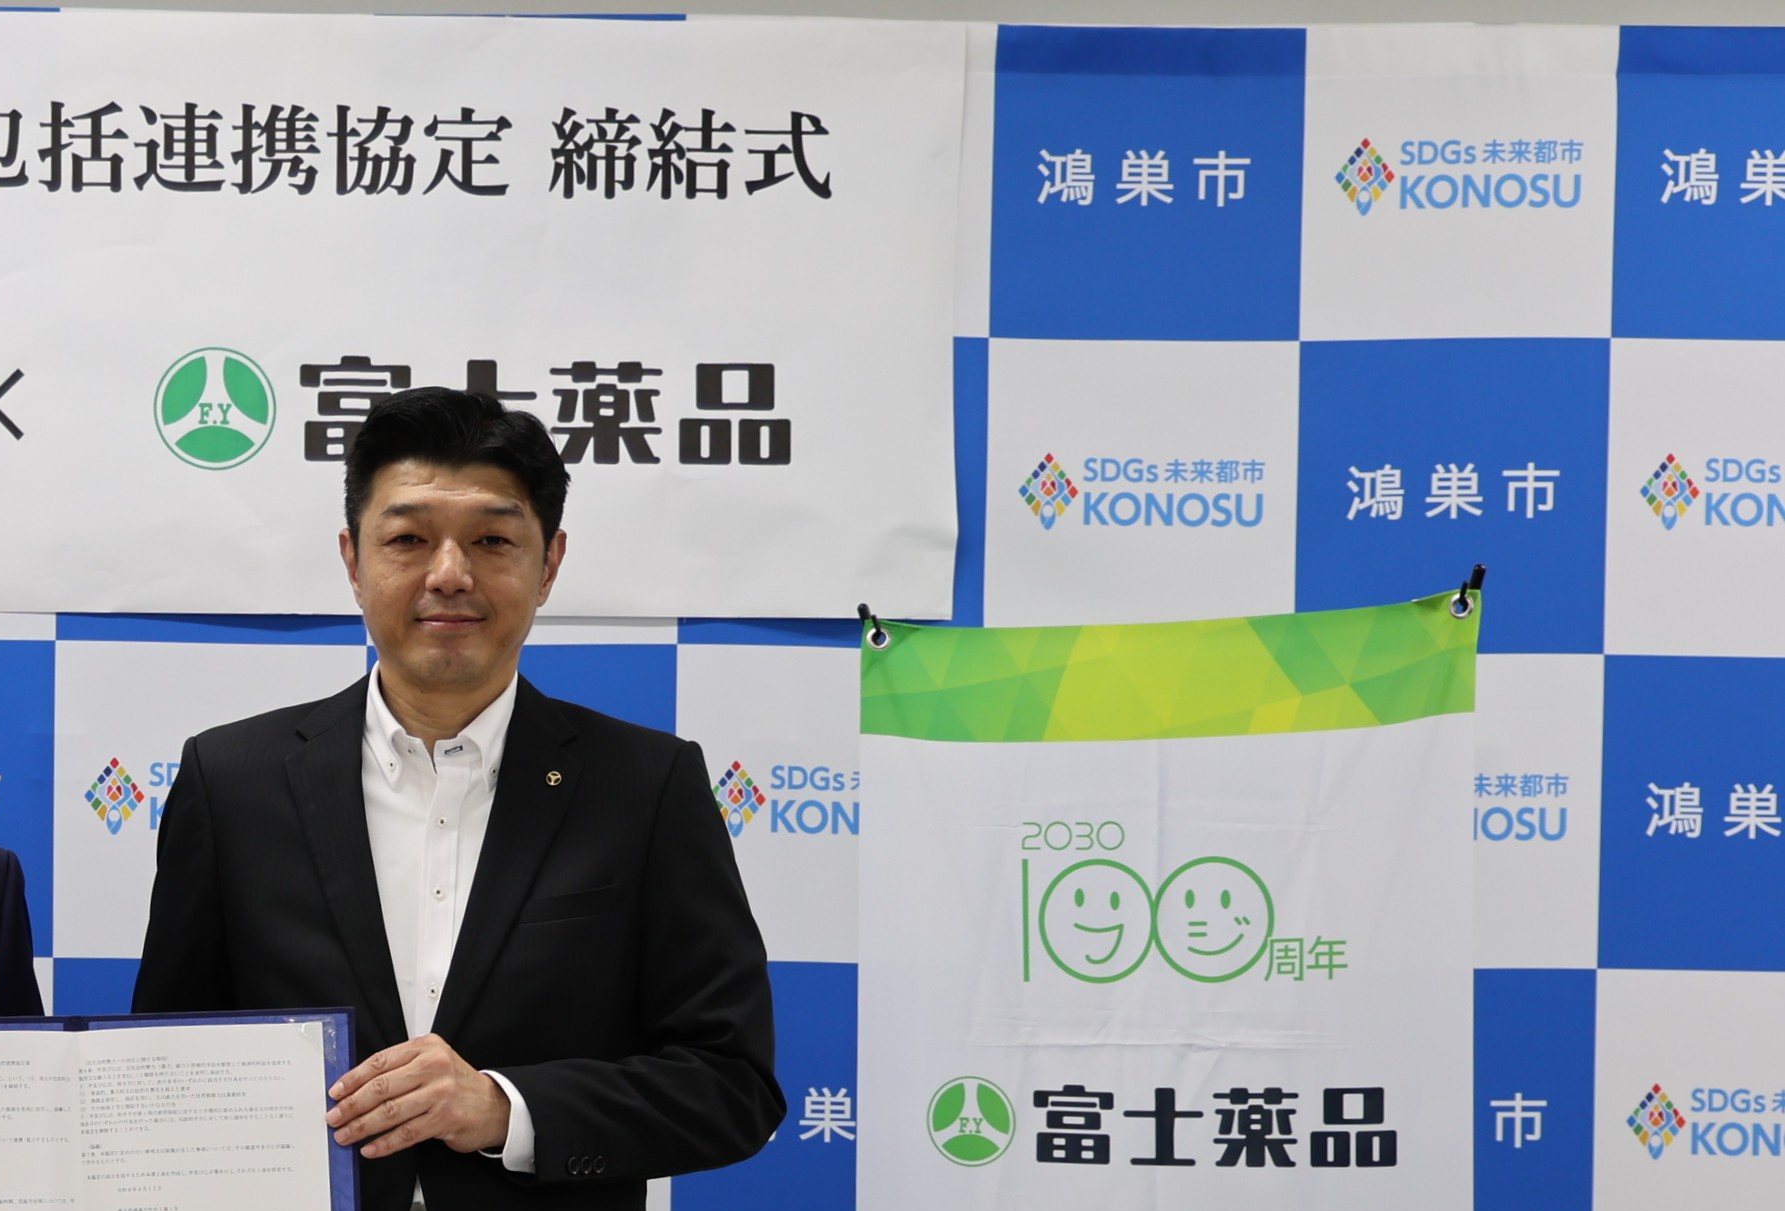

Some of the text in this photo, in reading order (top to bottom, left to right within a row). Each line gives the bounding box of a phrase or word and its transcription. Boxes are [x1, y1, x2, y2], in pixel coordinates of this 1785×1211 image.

[550, 108, 831, 199] 締結式
[1401, 140, 1580, 165] SDGs 未来都市
[1038, 149, 1251, 207] 鴻巣市
[1401, 174, 1581, 208] KONOSU
[1085, 458, 1262, 482] SDGs 未来都市
[1707, 459, 1781, 483] SDGs
[1347, 462, 1560, 520] 鴻巣市
[1084, 492, 1263, 527] KONOSU
[772, 765, 844, 791] SDGs
[1020, 821, 1126, 851] 2030
[1475, 807, 1567, 841] OSU
[1692, 1088, 1765, 1113] SDGs
[1034, 1085, 1397, 1167] 富士薬品
